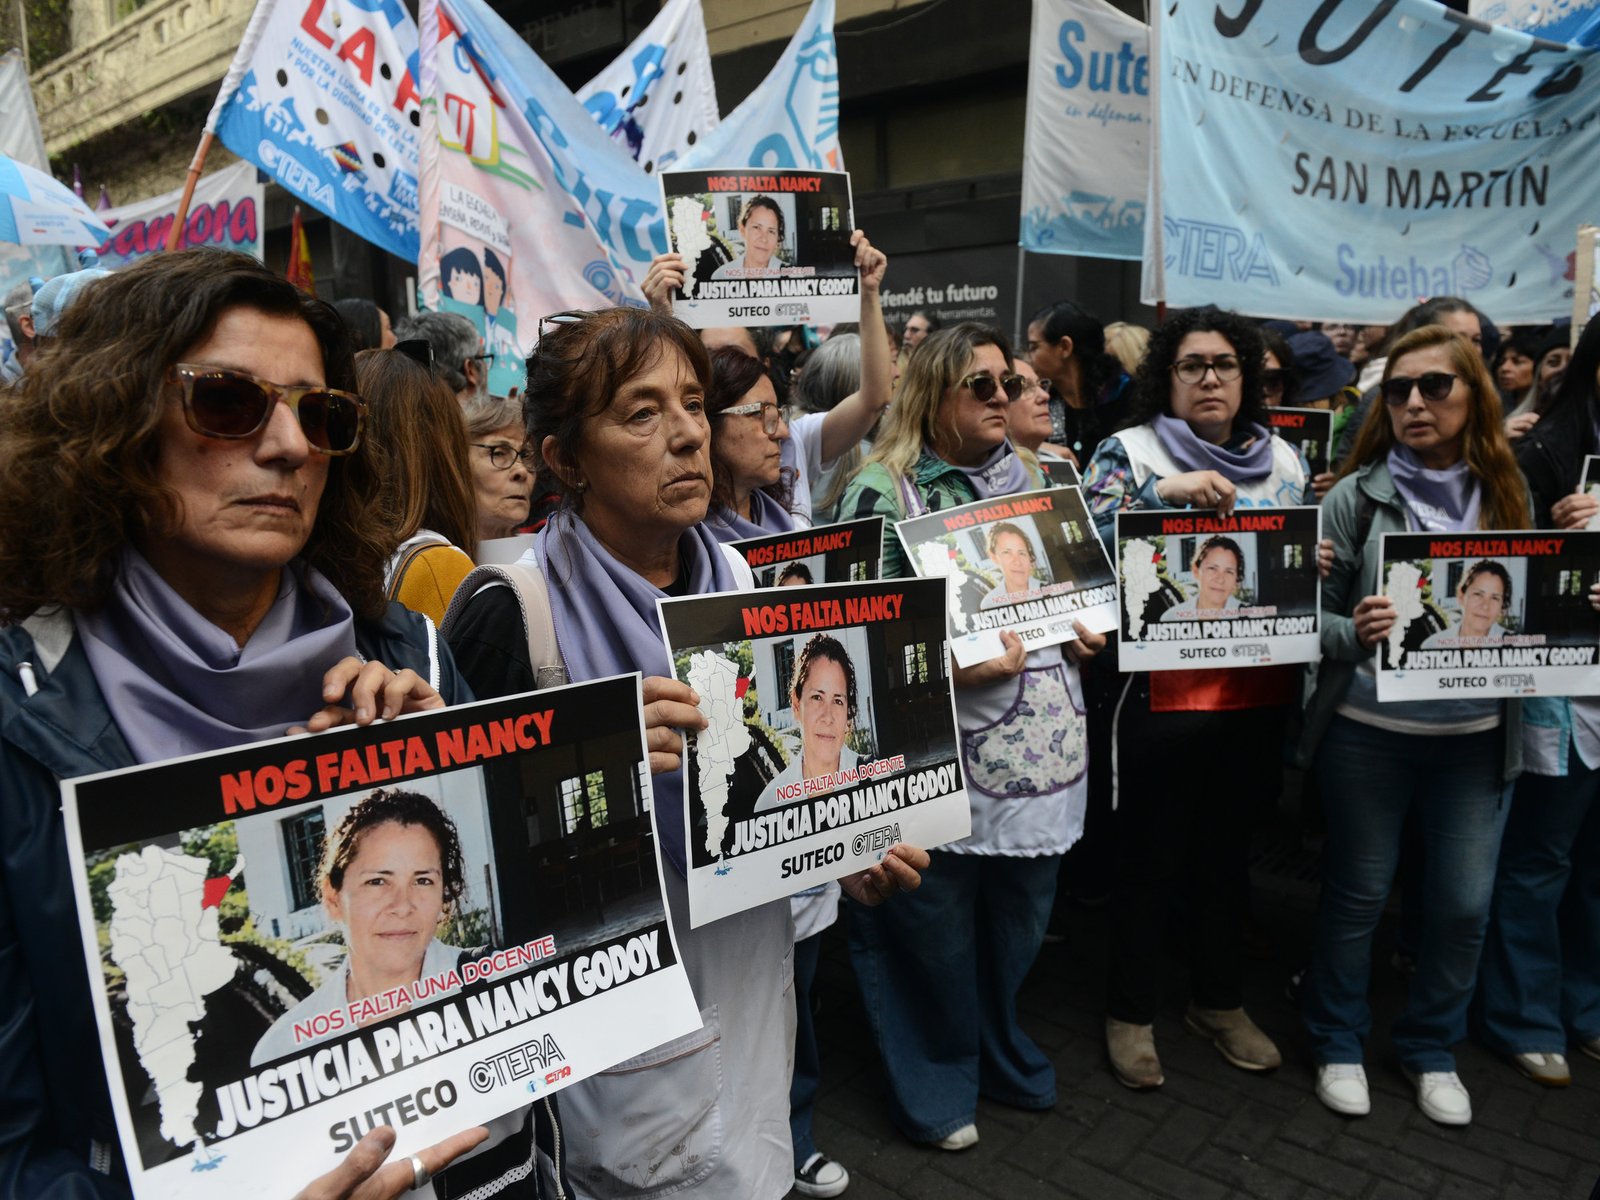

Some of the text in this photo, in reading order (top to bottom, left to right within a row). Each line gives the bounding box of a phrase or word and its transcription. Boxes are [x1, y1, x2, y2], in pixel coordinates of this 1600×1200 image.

[1055, 19, 1149, 97] Sute
[290, 37, 337, 78] NUESTRA
[367, 101, 381, 116] ES
[382, 113, 401, 133] POR
[294, 58, 316, 79] POR
[316, 75, 330, 91] LA
[332, 88, 373, 126] DIGNIDAD
[1209, 69, 1334, 124] DEFENSA
[1344, 104, 1385, 134] DE
[1394, 118, 1431, 142] LA
[1441, 117, 1574, 142] ESCUELA
[257, 138, 337, 216] CTERA
[706, 176, 821, 192] NOS FALTA NANCY
[1291, 151, 1369, 205] SAN
[697, 278, 855, 300] JUSTICIA PARA NANCY GODOY
[725, 268, 742, 276] NOS
[743, 268, 764, 276] FALTA
[1335, 243, 1452, 300] Suteba
[728, 303, 810, 318] SUTECO CTERA
[926, 287, 943, 304] tu
[946, 284, 998, 302] futuro
[943, 497, 1054, 532] NOS FALTA NANCY
[1162, 515, 1286, 534] NOS FALTA NANCY
[747, 530, 854, 566] NOS FALTA NANCY
[1429, 539, 1565, 557] NOS FALTA NANCY
[741, 594, 904, 637] NOS FALTA NANCY
[971, 584, 1118, 632] JUSTICIA PARA NANCY GODOY
[1176, 610, 1192, 618] NOS
[1016, 618, 1074, 642] TECO CTER
[1145, 616, 1315, 642] JUSTICIA POR NANCY GODOY
[1437, 637, 1457, 646] NOS
[1179, 644, 1271, 659] SUTECO CTERA
[1405, 647, 1596, 670] JUSTICIA PARA NANCY GODOY
[1438, 674, 1536, 688] SUTECO CTERA
[219, 709, 555, 815] NOS FALTA NANCY
[776, 754, 906, 802] NOS FALTA UNA DOCENTE
[730, 763, 959, 856] JUSTICIA POR NANCY GODOY
[781, 823, 902, 879] SUTECO CTERA
[293, 935, 556, 1045] NOS FALTA UNA DOCENTE
[214, 930, 663, 1139] JUSTICIA PARA NANCY GODOY
[329, 1033, 566, 1154] SUTECO CTERA
